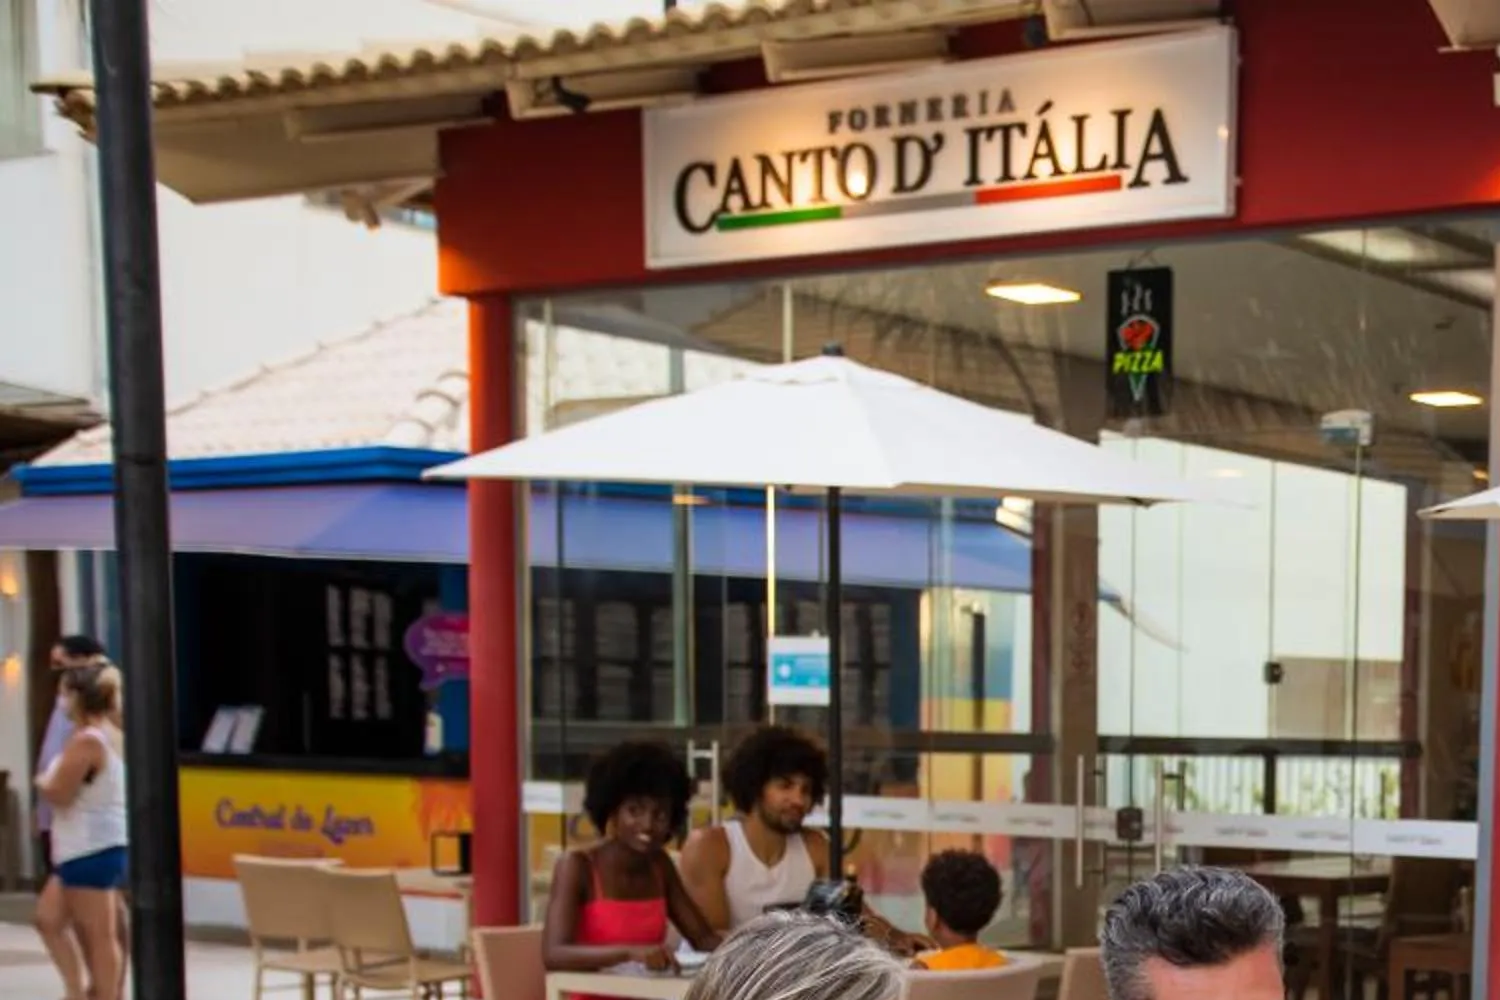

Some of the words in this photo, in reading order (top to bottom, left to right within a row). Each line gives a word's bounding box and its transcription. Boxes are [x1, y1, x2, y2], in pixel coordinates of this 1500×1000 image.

[827, 88, 1016, 134] FORNERIA
[674, 142, 878, 236] CANTO
[1112, 350, 1164, 375] PIZZA
